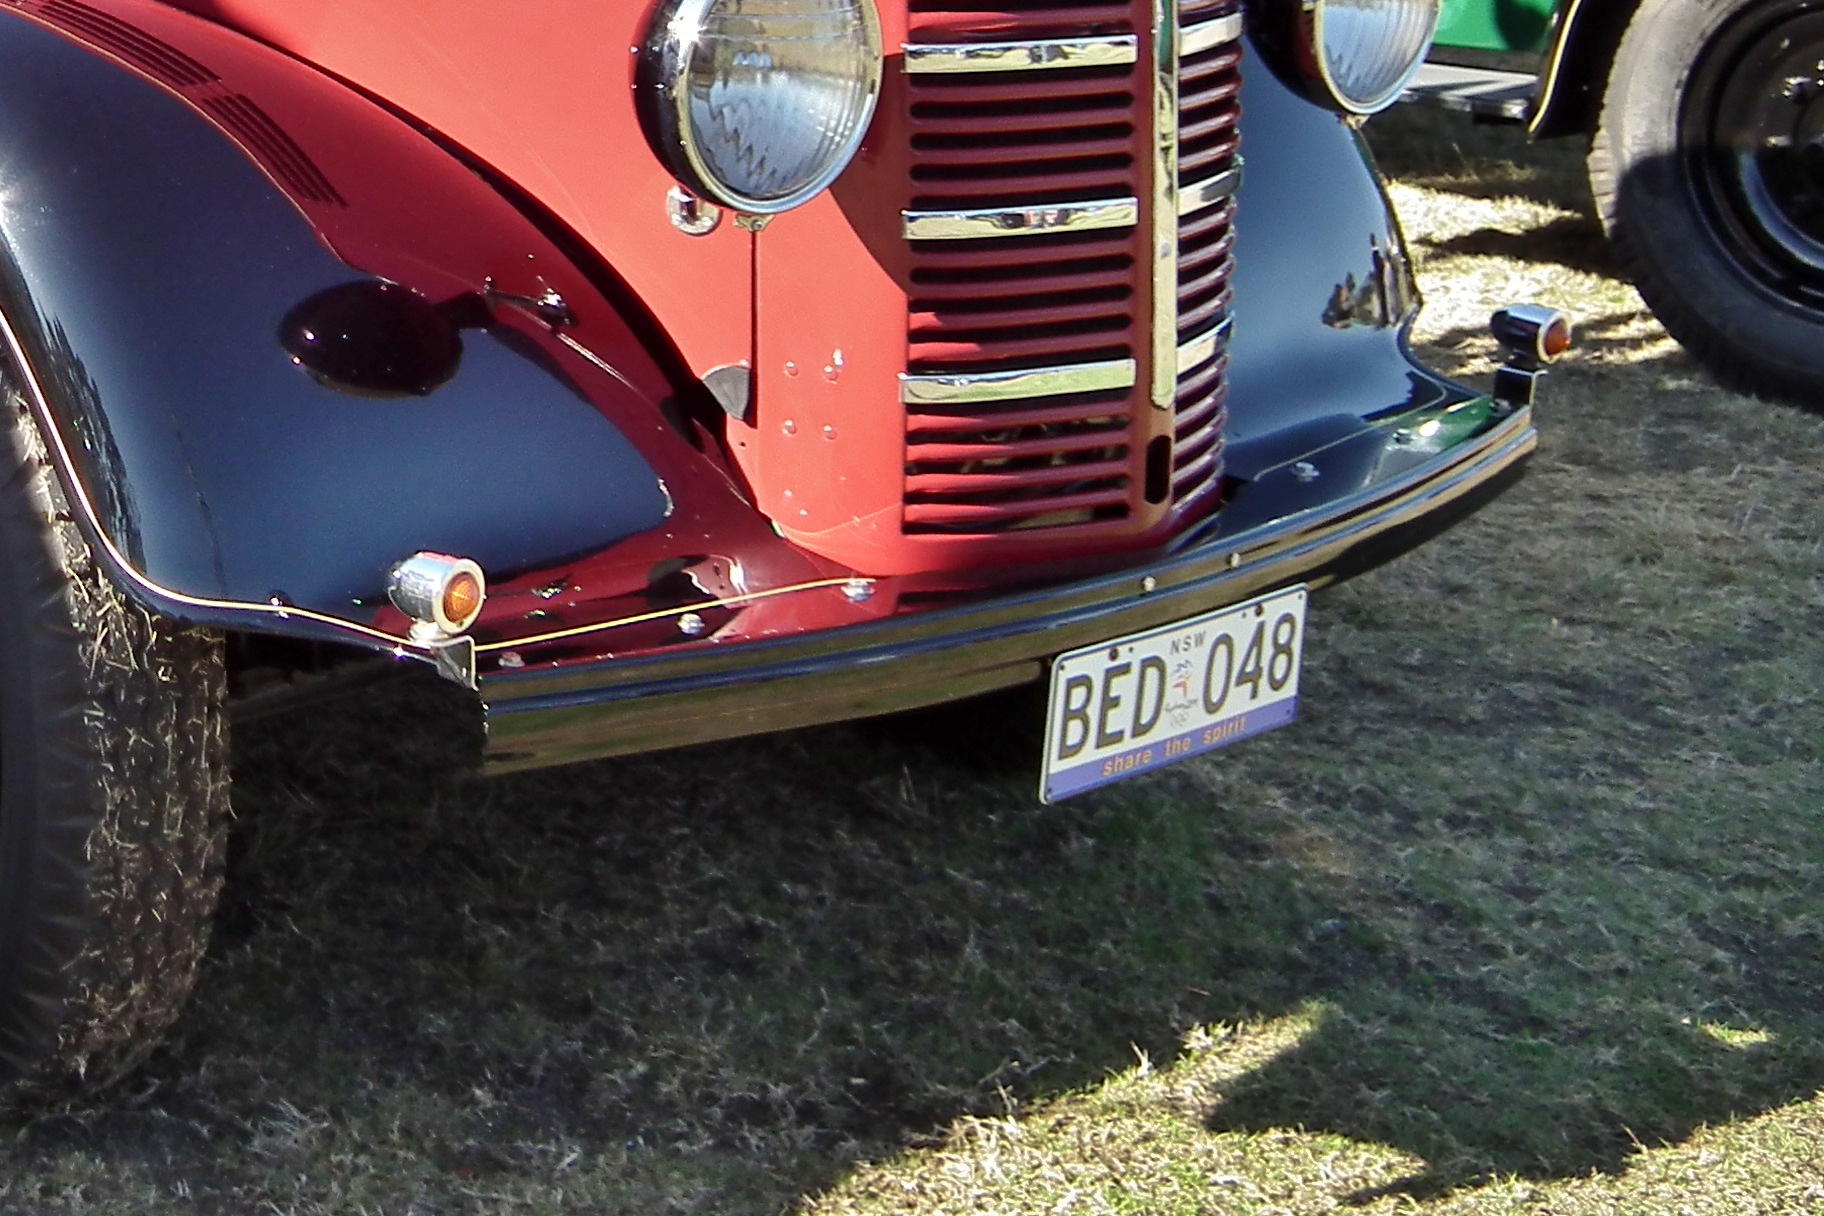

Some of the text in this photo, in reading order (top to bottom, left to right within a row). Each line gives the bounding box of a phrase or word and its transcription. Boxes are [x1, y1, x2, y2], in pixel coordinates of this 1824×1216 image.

[1169, 631, 1207, 656] NSW
[1058, 612, 1296, 761] BED 048
[1102, 749, 1152, 776] share
[1164, 736, 1191, 758] the
[1203, 717, 1246, 745] spirit
